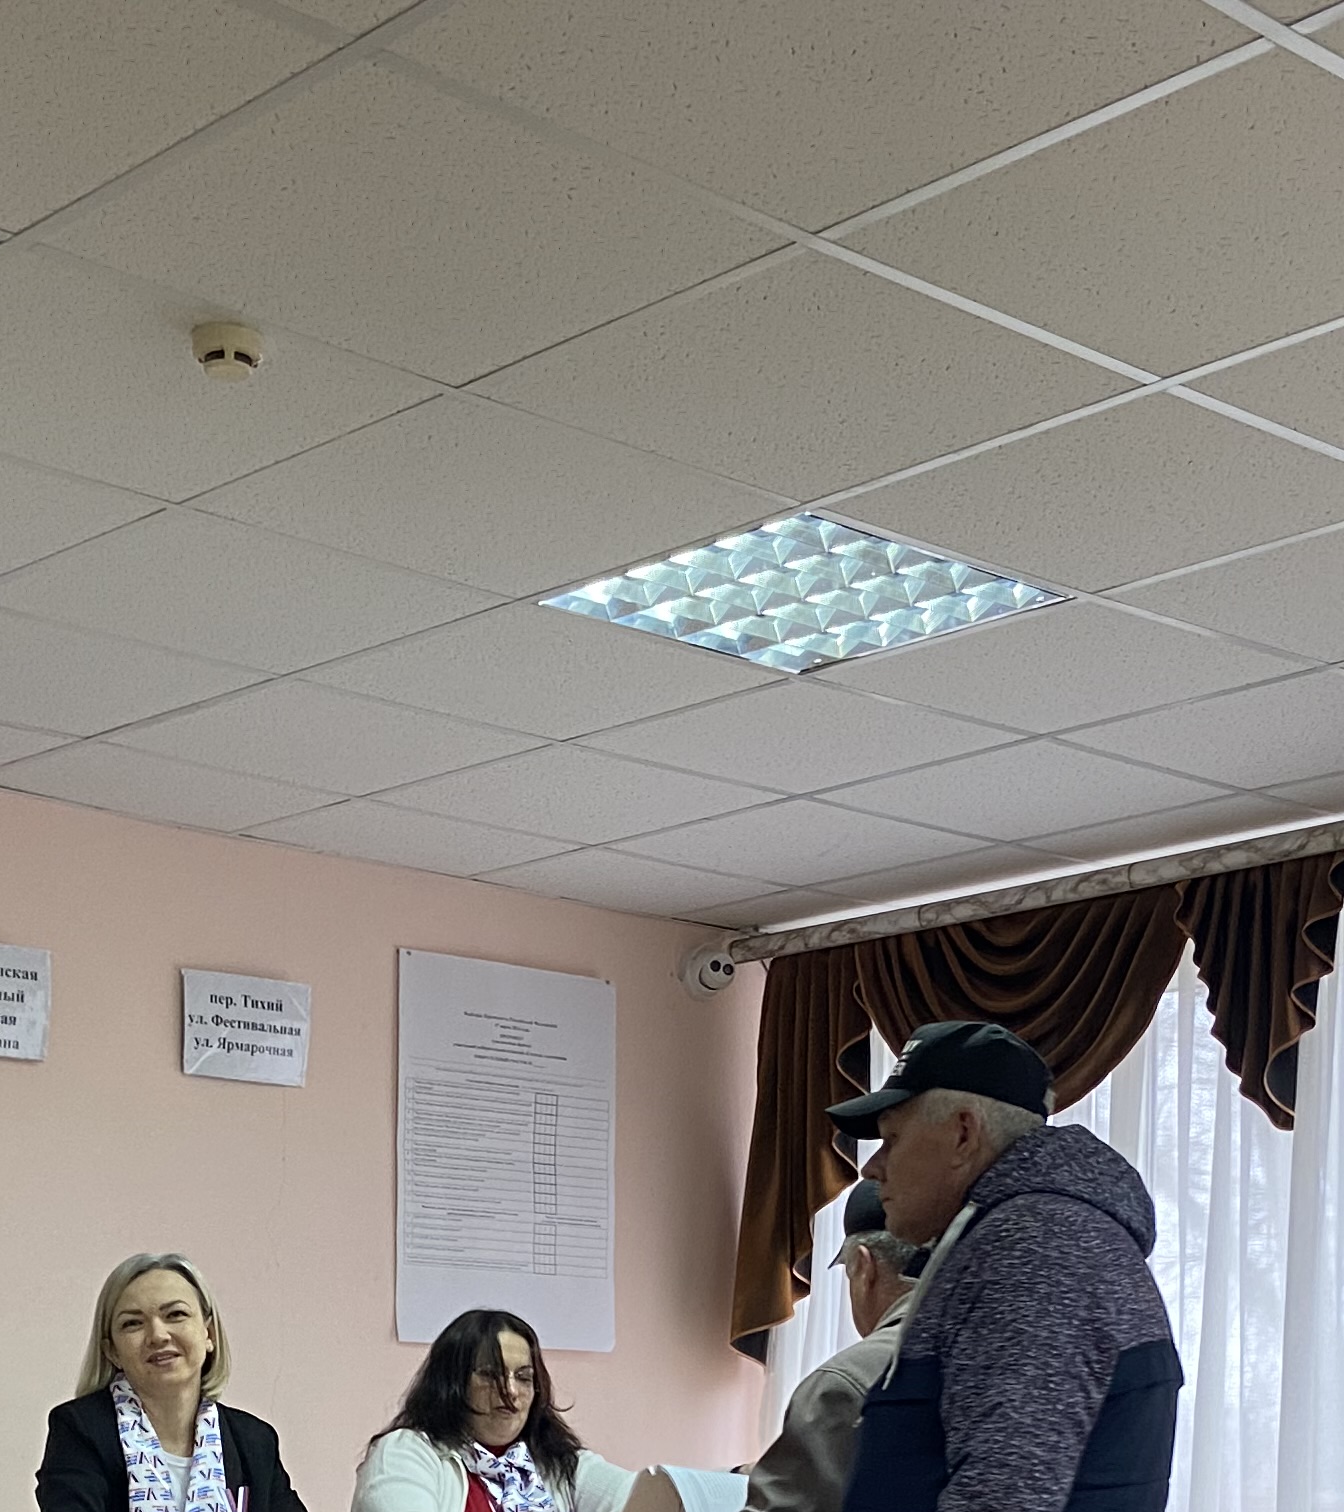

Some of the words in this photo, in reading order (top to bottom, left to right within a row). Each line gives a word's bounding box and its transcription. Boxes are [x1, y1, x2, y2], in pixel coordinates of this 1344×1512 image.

[209, 993, 237, 1009] пер.
[241, 994, 283, 1012] Тихий
[188, 1014, 208, 1027] ул.
[211, 1014, 301, 1036] Фестивальная
[194, 1036, 213, 1050] ул.
[217, 1036, 294, 1057] Ярмарочная
